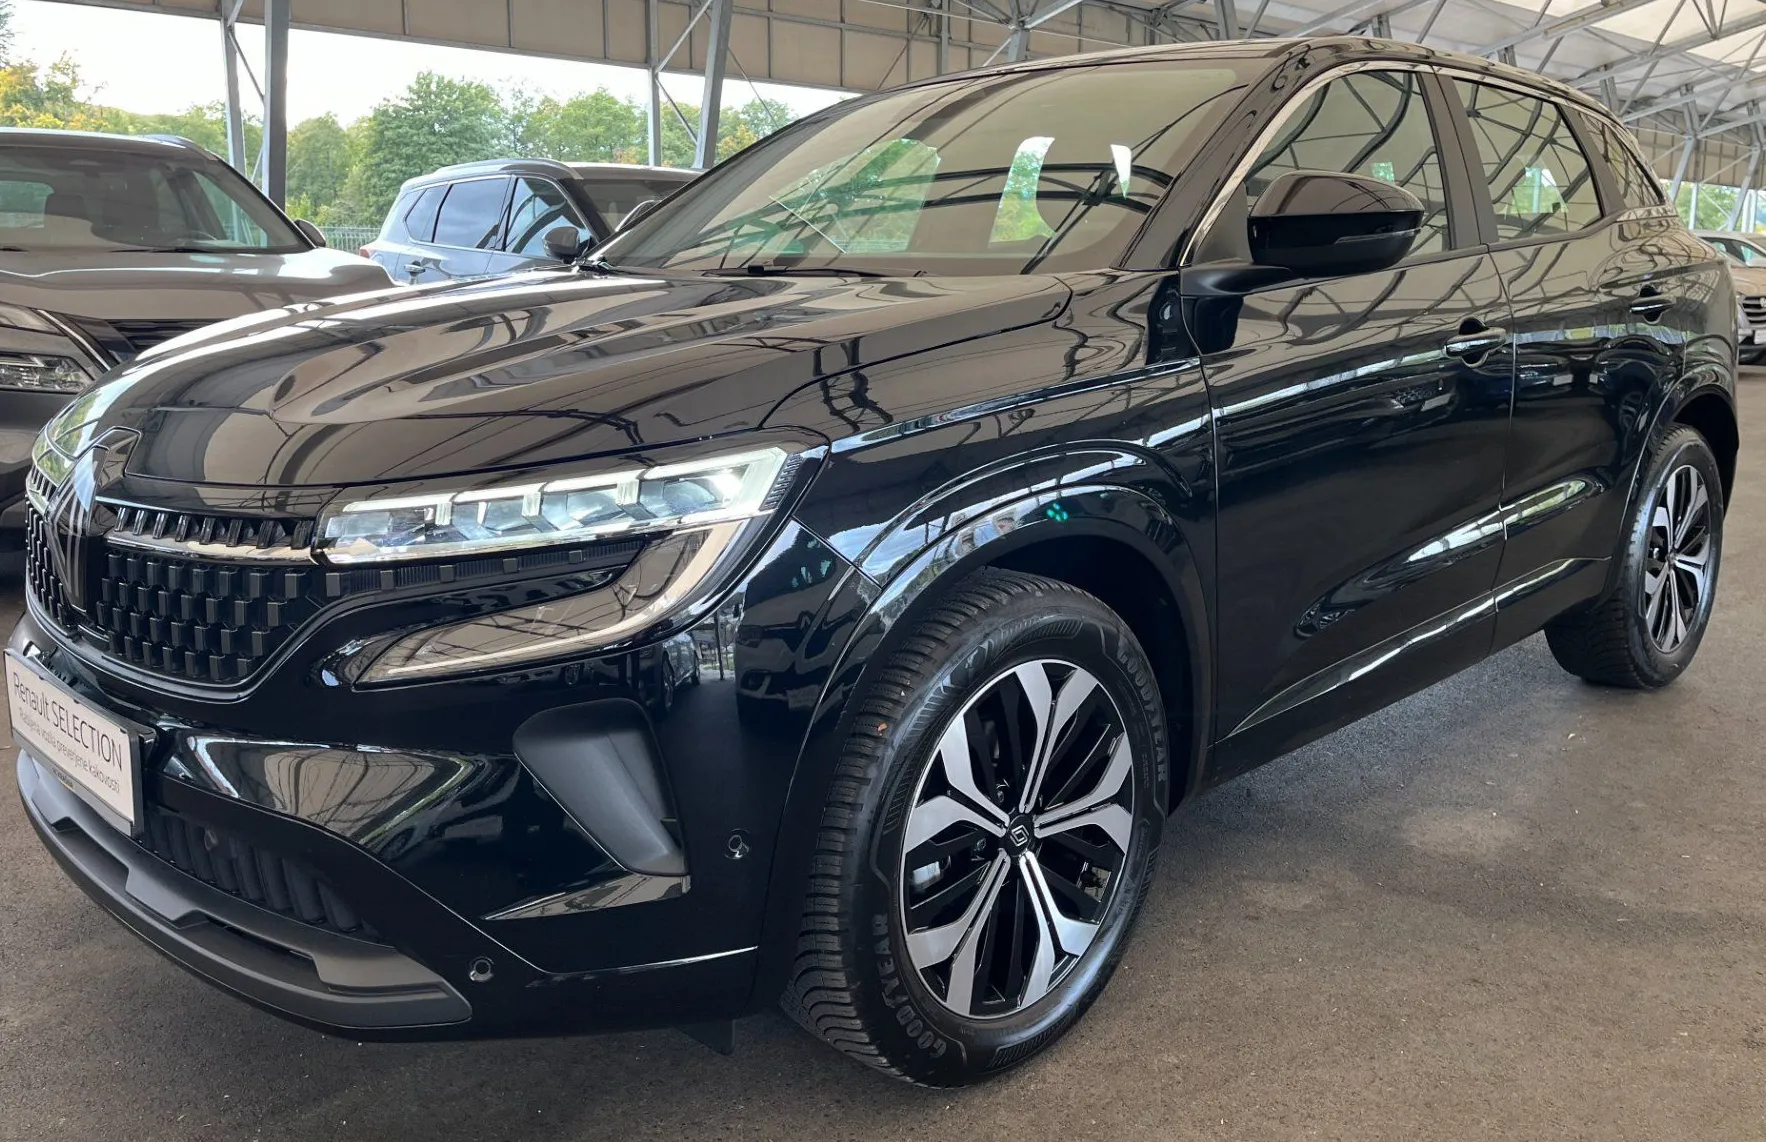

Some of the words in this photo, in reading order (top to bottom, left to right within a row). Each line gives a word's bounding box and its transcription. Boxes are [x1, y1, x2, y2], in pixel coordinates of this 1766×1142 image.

[13, 671, 50, 722] Renault
[52, 700, 122, 772] SELECTION
[871, 913, 947, 1059] GOODYEAR
